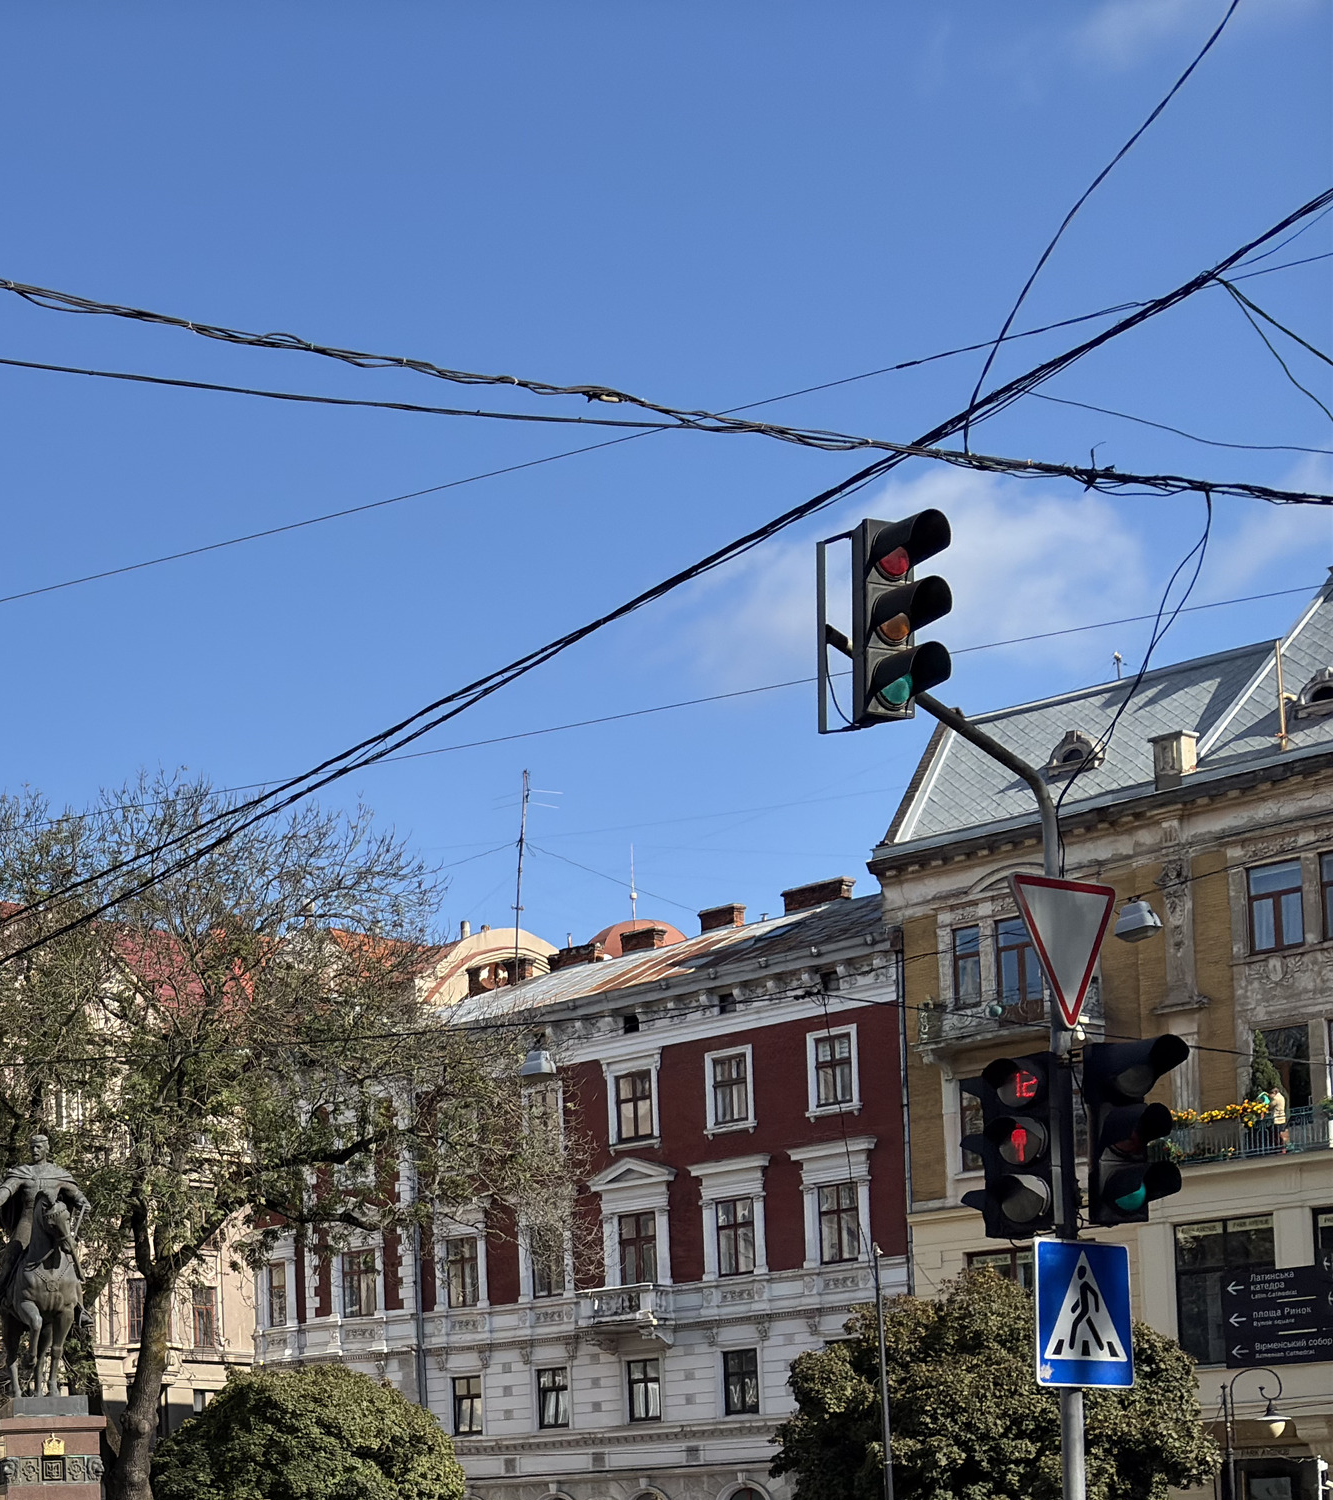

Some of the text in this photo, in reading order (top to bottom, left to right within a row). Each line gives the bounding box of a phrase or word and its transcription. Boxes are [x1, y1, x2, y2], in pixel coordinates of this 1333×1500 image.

[1015, 1069, 1038, 1098] 12
[1250, 1270, 1295, 1282] Латинська
[1253, 1306, 1312, 1319] площа Ринок
[1274, 1318, 1295, 1326] square
[1255, 1337, 1333, 1351] Вірменський собор
